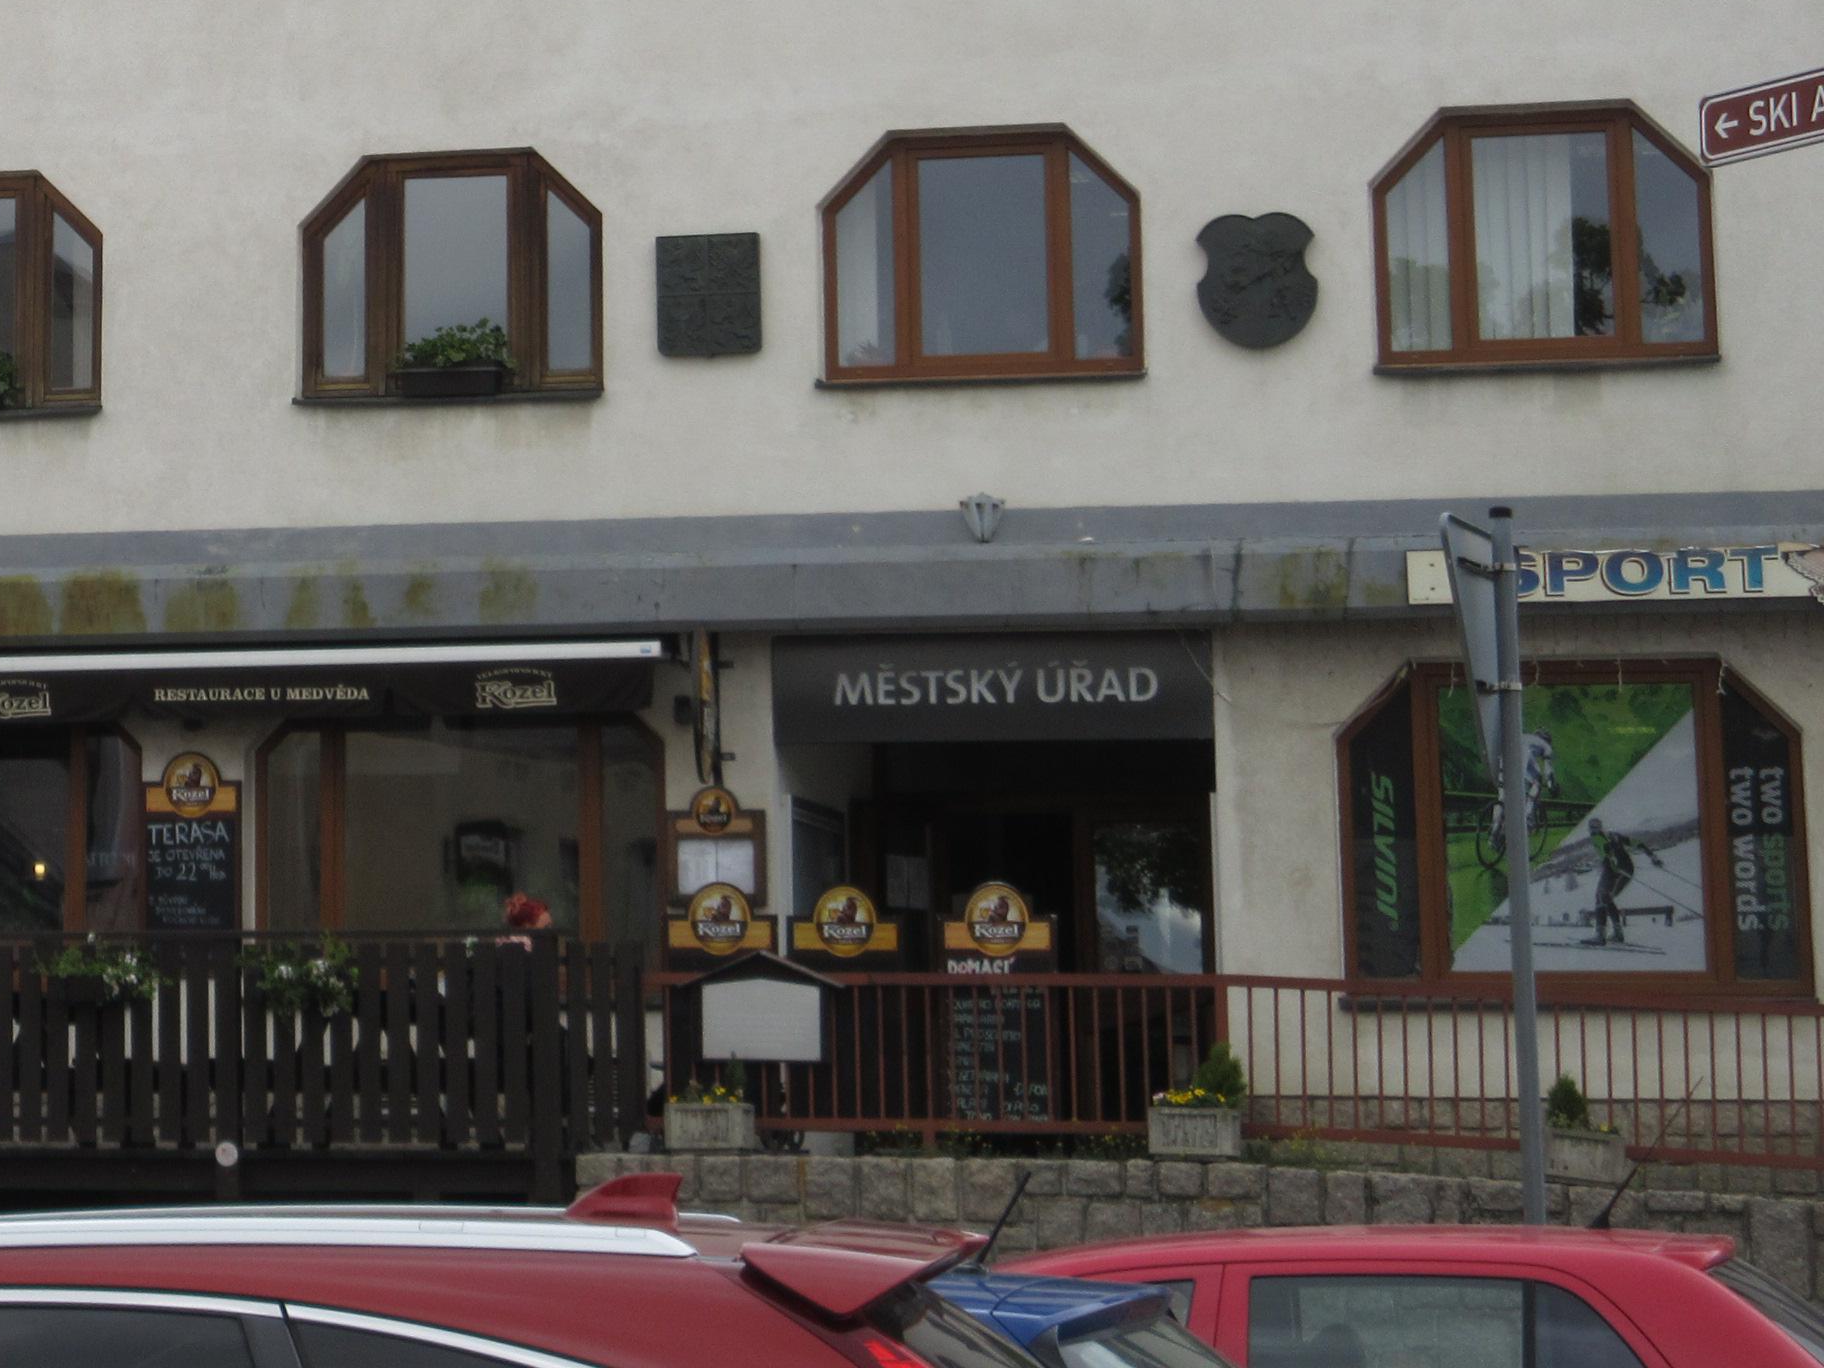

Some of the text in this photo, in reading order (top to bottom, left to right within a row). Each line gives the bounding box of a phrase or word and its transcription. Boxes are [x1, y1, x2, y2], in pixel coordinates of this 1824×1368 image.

[1748, 91, 1798, 136] SKI
[154, 687, 266, 702] RESTAURACE
[270, 687, 281, 700] U
[474, 679, 558, 709] Kozel
[833, 659, 1159, 706] MĚSTSKÝ ÚŘAD
[147, 821, 230, 846] TERASA
[1728, 765, 1767, 931] two words
[1758, 765, 1791, 931] two sports
[697, 922, 741, 937] Kozel
[821, 922, 867, 939] Kozel
[973, 922, 1019, 939] Kozel
